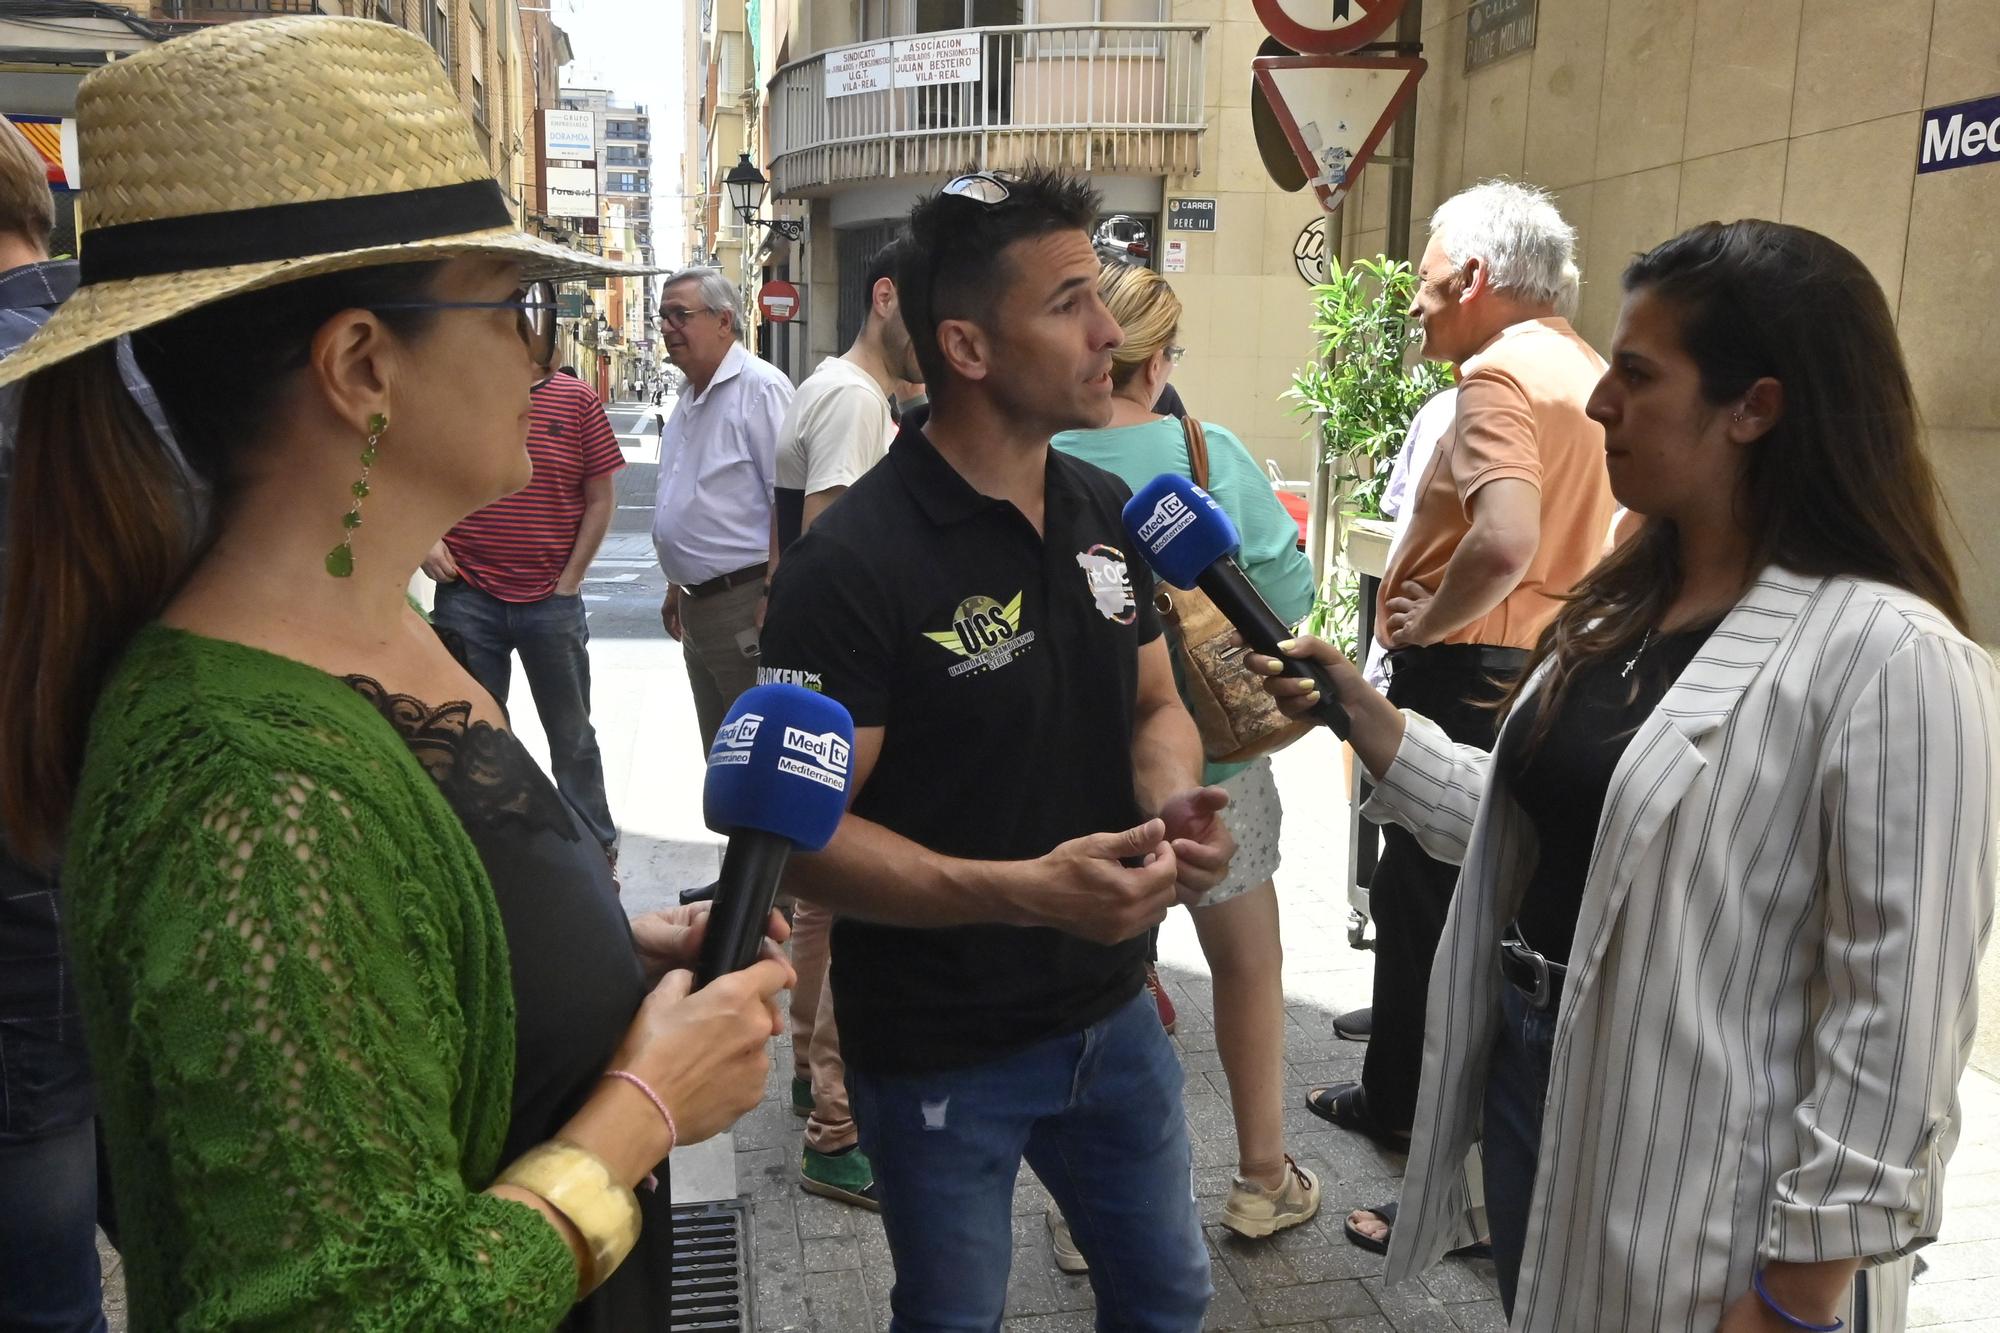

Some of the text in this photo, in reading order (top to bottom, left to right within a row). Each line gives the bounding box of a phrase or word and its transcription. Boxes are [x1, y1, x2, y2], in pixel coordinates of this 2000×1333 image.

[909, 38, 962, 52] ASOCIACION
[843, 48, 876, 63] SINDICATO
[859, 56, 890, 69] PENSIONISTAS
[901, 52, 931, 63] JUBILADOS
[936, 47, 980, 59] PENSIONISTAS
[895, 57, 972, 73] JULIAN BESTEIRO
[848, 70, 869, 80] U.G.T.
[563, 114, 589, 122] GRUPO
[1173, 218, 1209, 229] PERE III
[1140, 512, 1167, 539] Medi
[1151, 514, 1195, 553] Mediterráneo
[953, 606, 1014, 655] UCS
[990, 631, 1035, 659] CHAMPIONSHIP
[989, 654, 1013, 670] SERIES
[741, 723, 757, 737] tv
[788, 732, 848, 763] Medi tv
[779, 758, 844, 789] Mediterráneo
